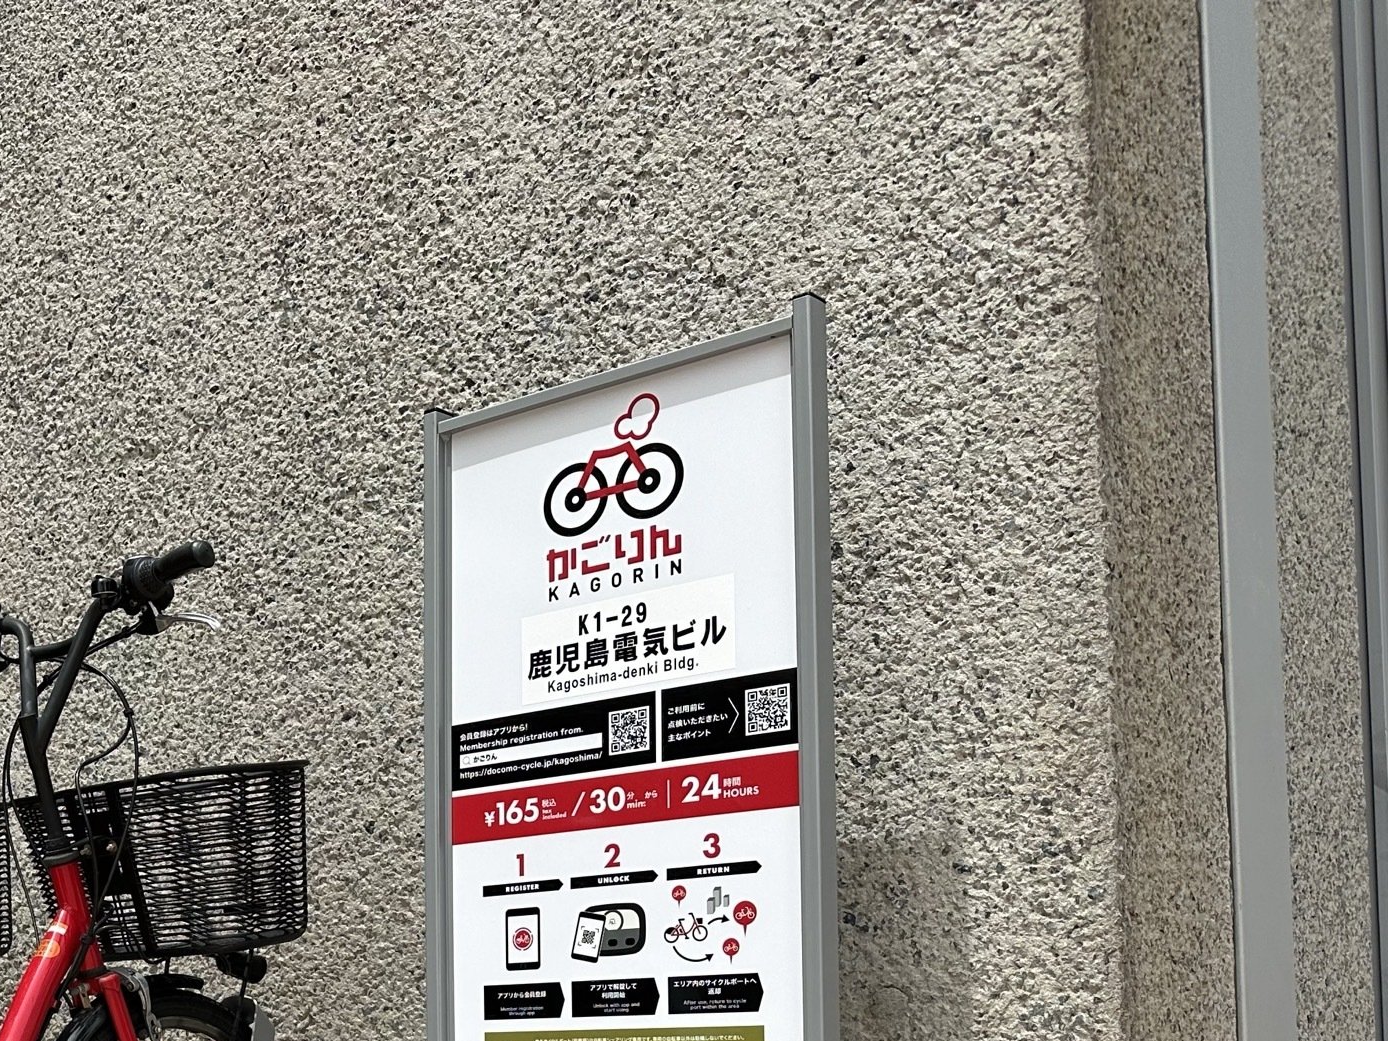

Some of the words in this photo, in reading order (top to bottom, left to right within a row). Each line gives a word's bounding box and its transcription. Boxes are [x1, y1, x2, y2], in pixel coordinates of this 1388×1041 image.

[546, 524, 682, 583] かごりん
[548, 558, 682, 602] KAGORIN
[578, 602, 647, 636] K1-29
[527, 616, 727, 681] 鹿児島電気ビル
[547, 661, 658, 693] Kagoshima-denki
[664, 656, 699, 673] Bldg.
[667, 703, 706, 715] ご利用前に
[459, 740, 508, 752] Membership
[510, 731, 559, 746] registration
[560, 727, 584, 737] from.
[667, 729, 712, 742] 主なポイント
[459, 751, 603, 779] https://docomo-cycle.jp/kagoshima/
[681, 773, 721, 803] 24
[723, 776, 741, 787] 時間
[723, 786, 760, 798] HOURS
[484, 797, 540, 827] ¥165
[604, 843, 620, 868] 2
[703, 833, 721, 859] 3
[516, 854, 524, 876] 1
[696, 866, 730, 875] RETURN
[505, 884, 540, 893] REGISTER
[597, 875, 630, 884] UNLOCK
